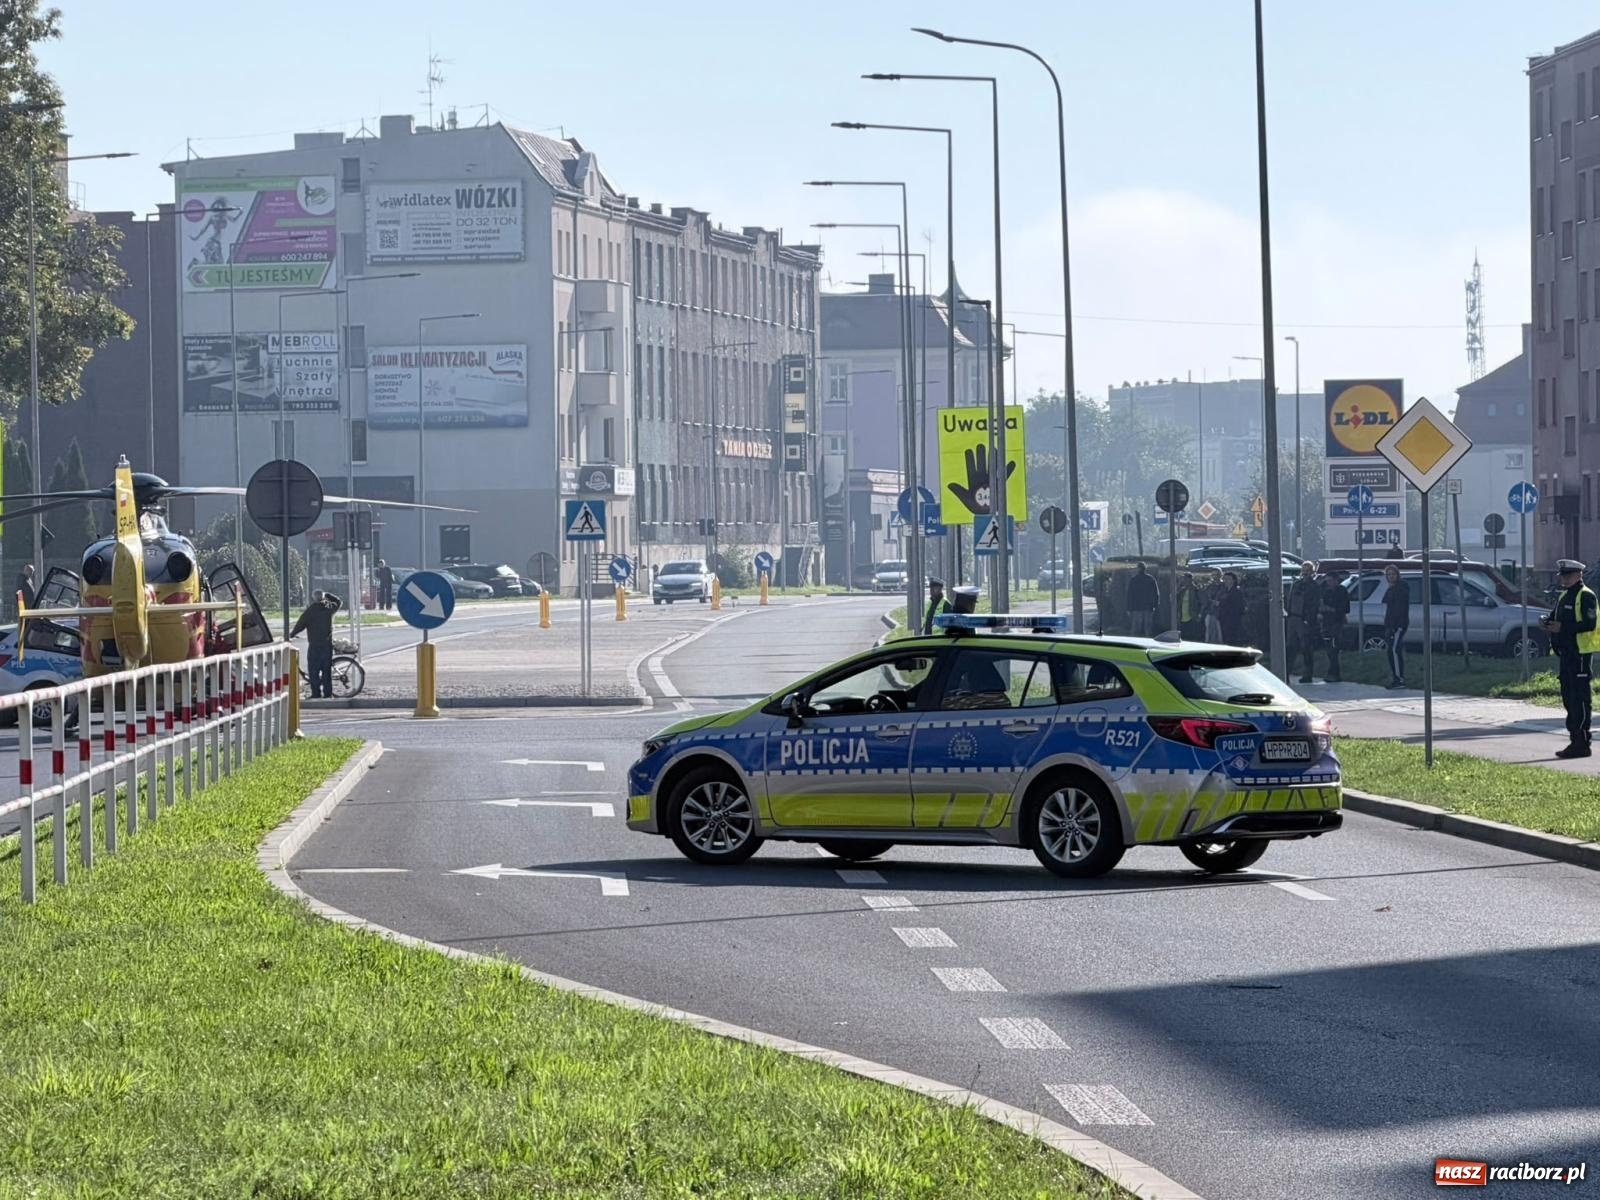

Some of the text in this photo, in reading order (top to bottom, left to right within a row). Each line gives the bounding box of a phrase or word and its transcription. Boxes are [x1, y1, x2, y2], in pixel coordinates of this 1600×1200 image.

[455, 184, 517, 209] WÓZKI
[456, 217, 517, 226] DO 32 TON
[216, 265, 314, 283] TU JESTEŚMY
[271, 335, 336, 347] MEBROLL
[371, 351, 487, 368] SALON KLIMATYZACJI
[496, 351, 523, 361] ALASKA
[296, 371, 332, 383] Szafy
[276, 386, 333, 397] Wnętrza
[1334, 405, 1394, 429] LIDL
[723, 440, 746, 457] TANIA
[1369, 507, 1388, 515] 6-22
[1105, 729, 1140, 747] R521
[1222, 738, 1255, 750] POLICJA
[781, 738, 870, 766] POLICJA
